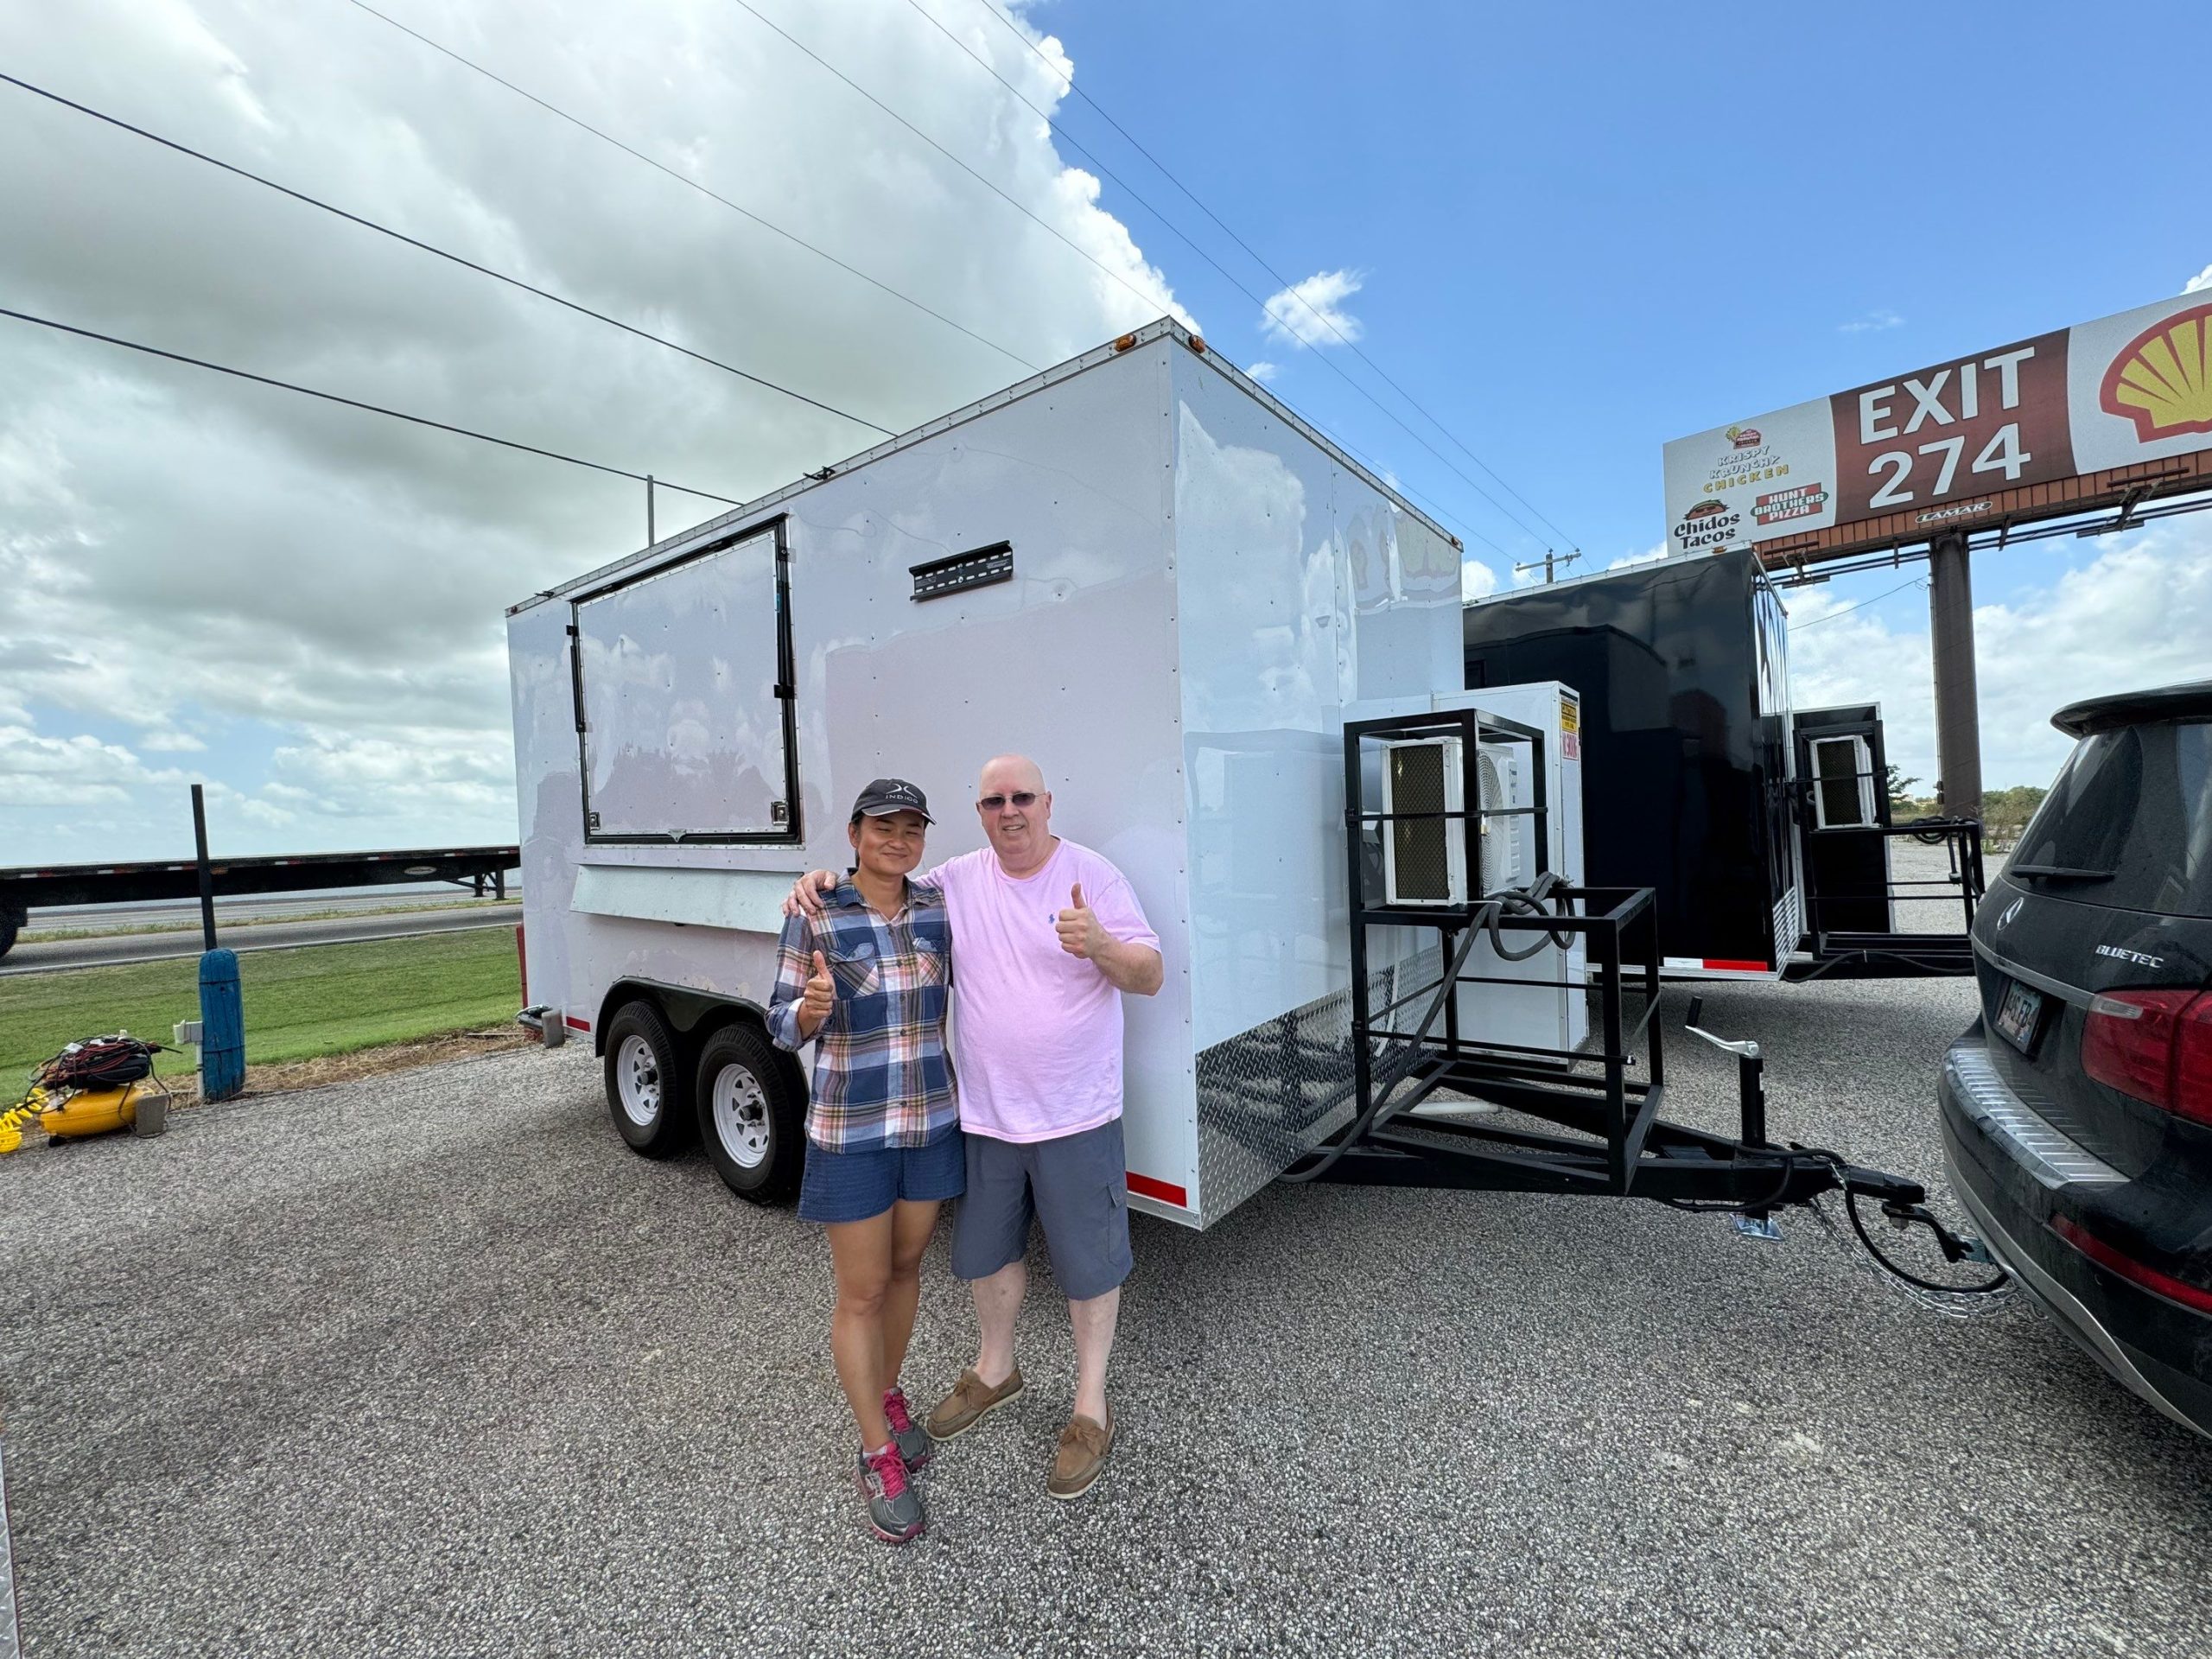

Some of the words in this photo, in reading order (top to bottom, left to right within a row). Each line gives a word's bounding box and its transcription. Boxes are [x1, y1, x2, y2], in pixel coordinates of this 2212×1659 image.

[1859, 346, 2035, 444] EXIT
[1709, 456, 1781, 479] KRUNCHY
[1718, 445, 1770, 467] KRISPY
[1868, 423, 2031, 509] 274
[1703, 464, 1789, 493] CHICKEN
[1754, 493, 1824, 516] BROTHERS
[1769, 488, 1807, 504] HUNT
[1769, 505, 1809, 521] PIZZA
[1922, 503, 1985, 521] LAMAR
[1674, 513, 1740, 537] Chidos
[1680, 528, 1735, 549] Tacos
[886, 794, 918, 804] INDIGO
[2095, 944, 2164, 968] BLUETEC
